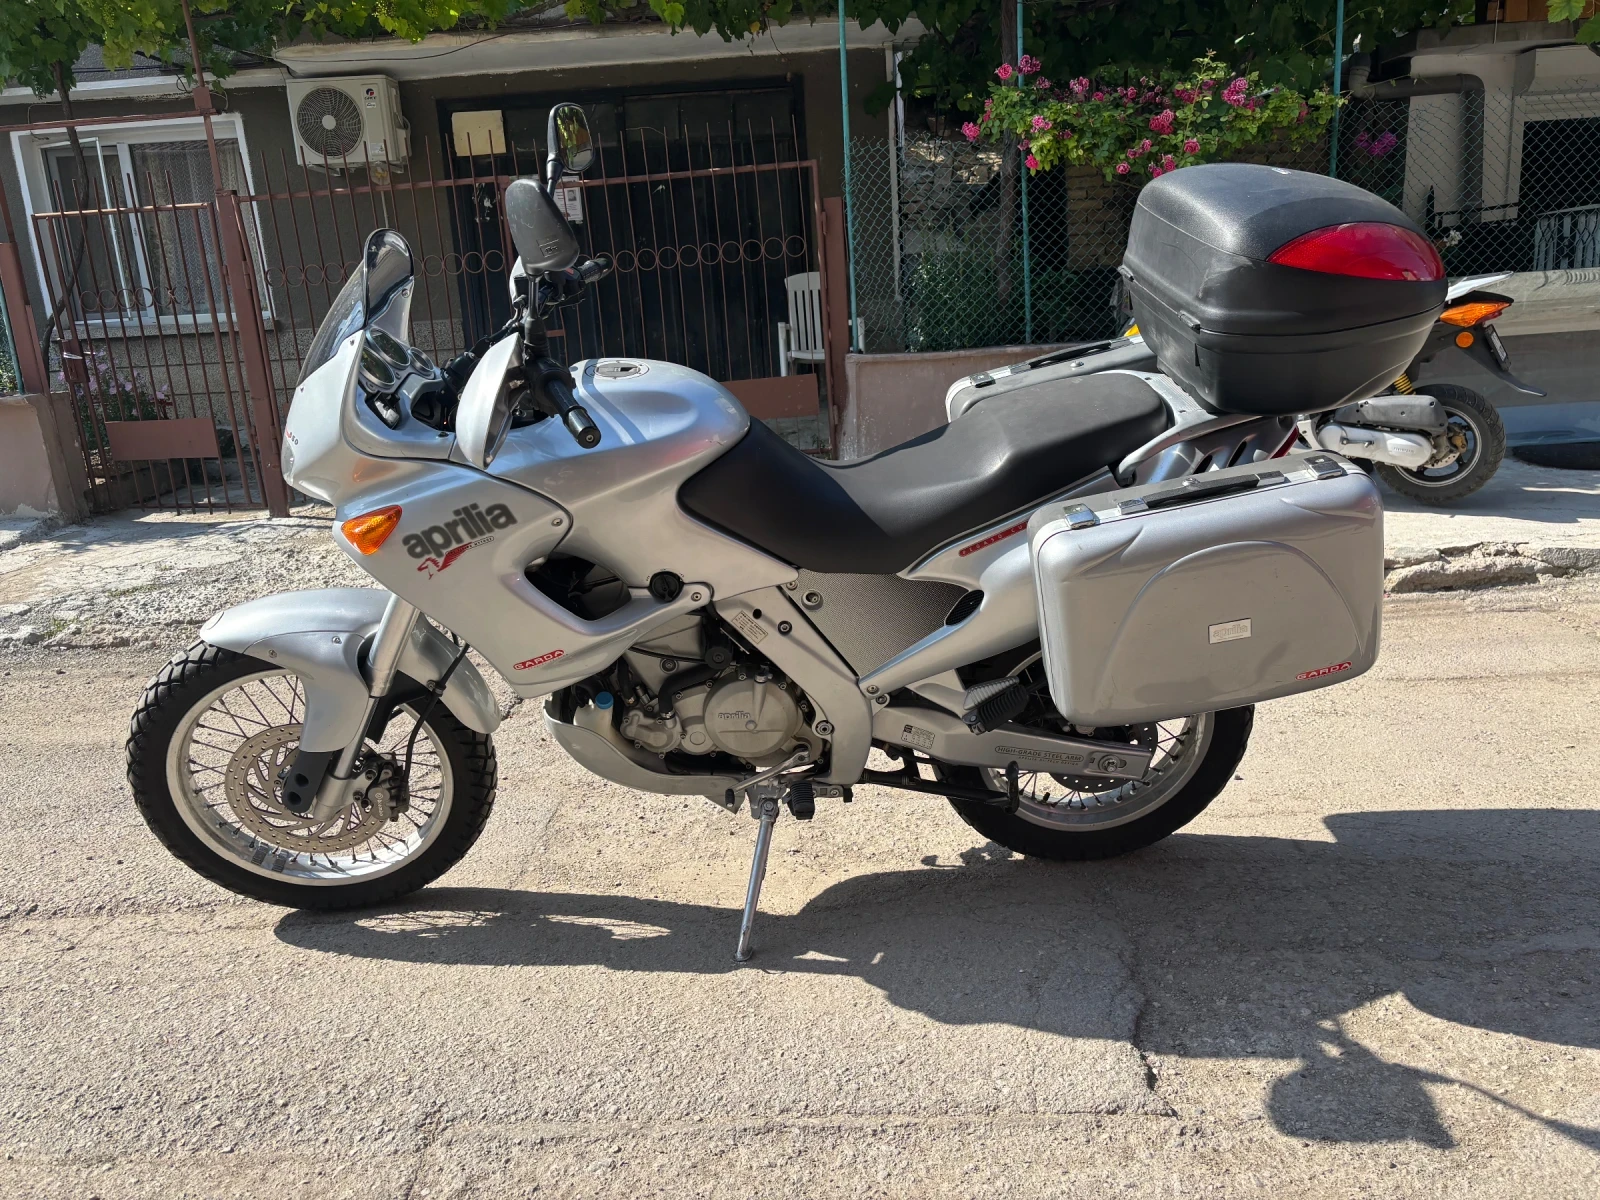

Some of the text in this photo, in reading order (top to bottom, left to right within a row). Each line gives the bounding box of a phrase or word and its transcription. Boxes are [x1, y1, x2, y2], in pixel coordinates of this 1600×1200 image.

[402, 502, 518, 559] aprilia
[1213, 624, 1248, 638] aprilia
[514, 650, 564, 670] GARDA
[1296, 662, 1350, 680] GARDA
[718, 710, 751, 720] aprilia
[997, 746, 1042, 758] HIGH-GRADE
[1043, 750, 1063, 759] STEEL
